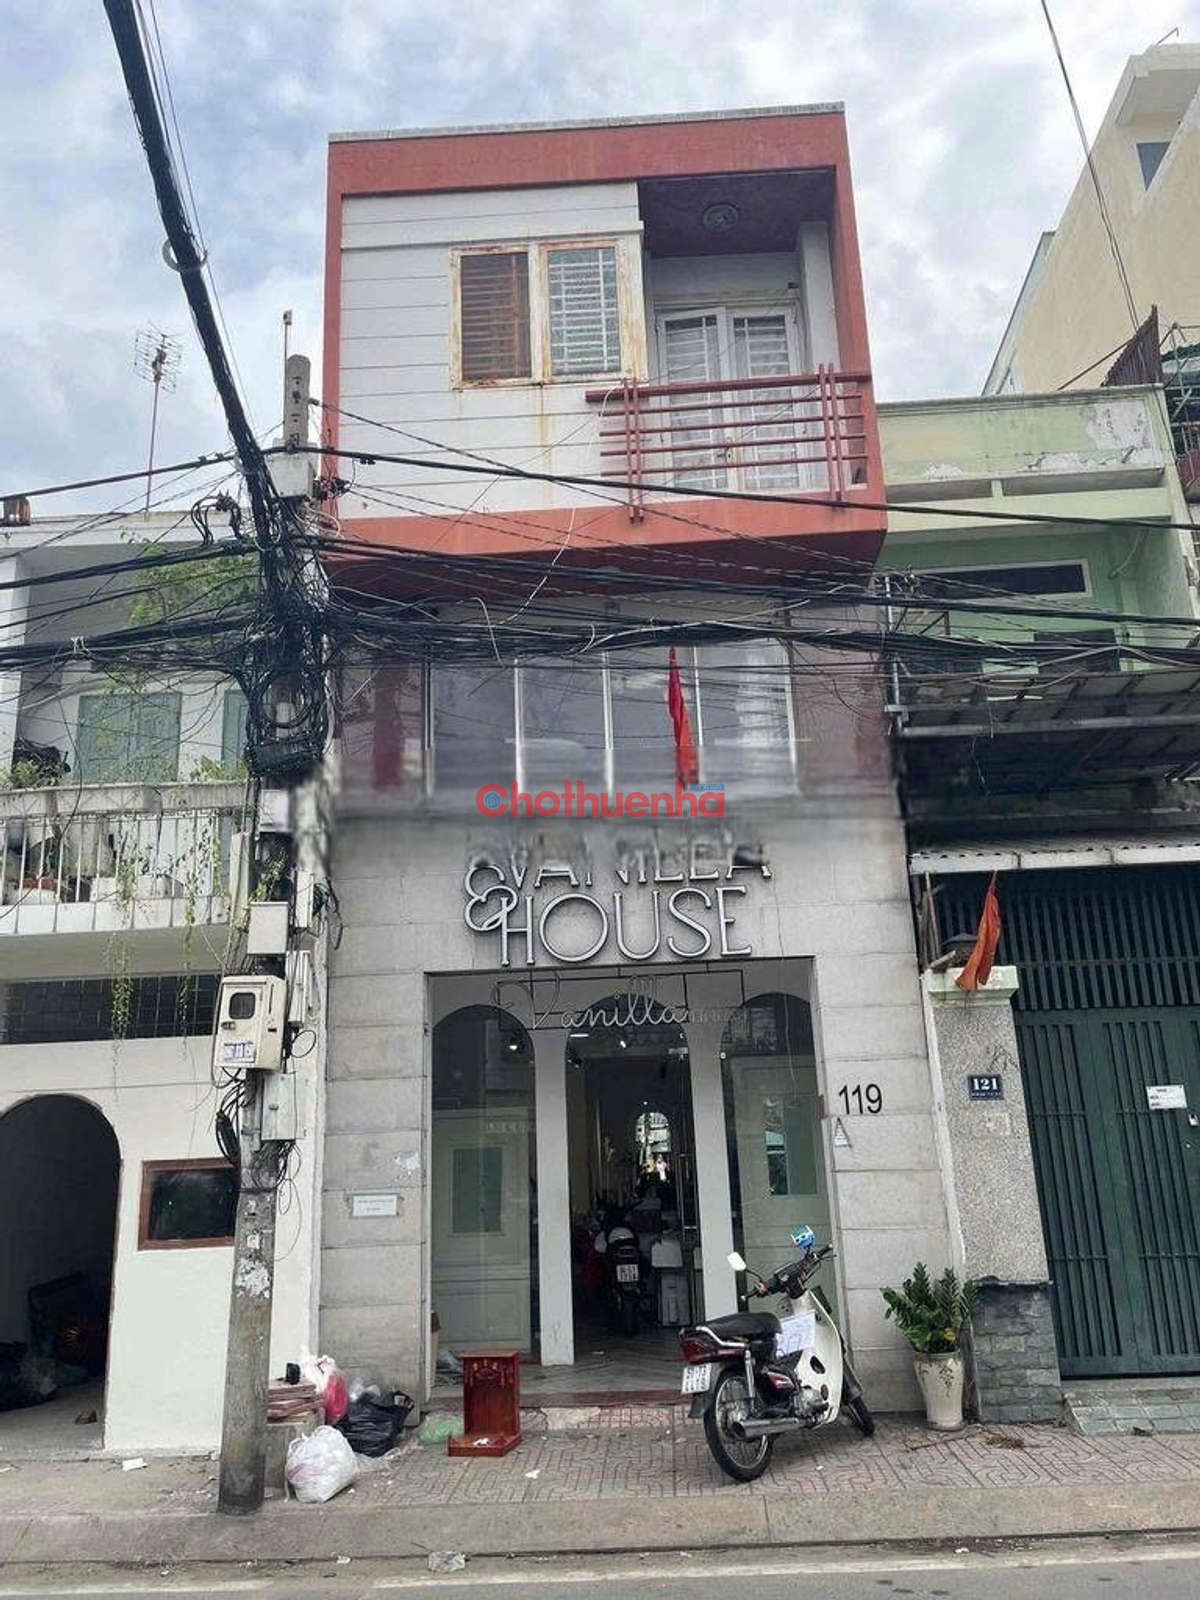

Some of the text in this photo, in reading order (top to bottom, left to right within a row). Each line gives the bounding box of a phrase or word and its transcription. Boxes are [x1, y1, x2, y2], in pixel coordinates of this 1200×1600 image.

[500, 885, 752, 966] HOUSE
[838, 1083, 883, 1115] 119
[973, 1078, 999, 1091] 121
